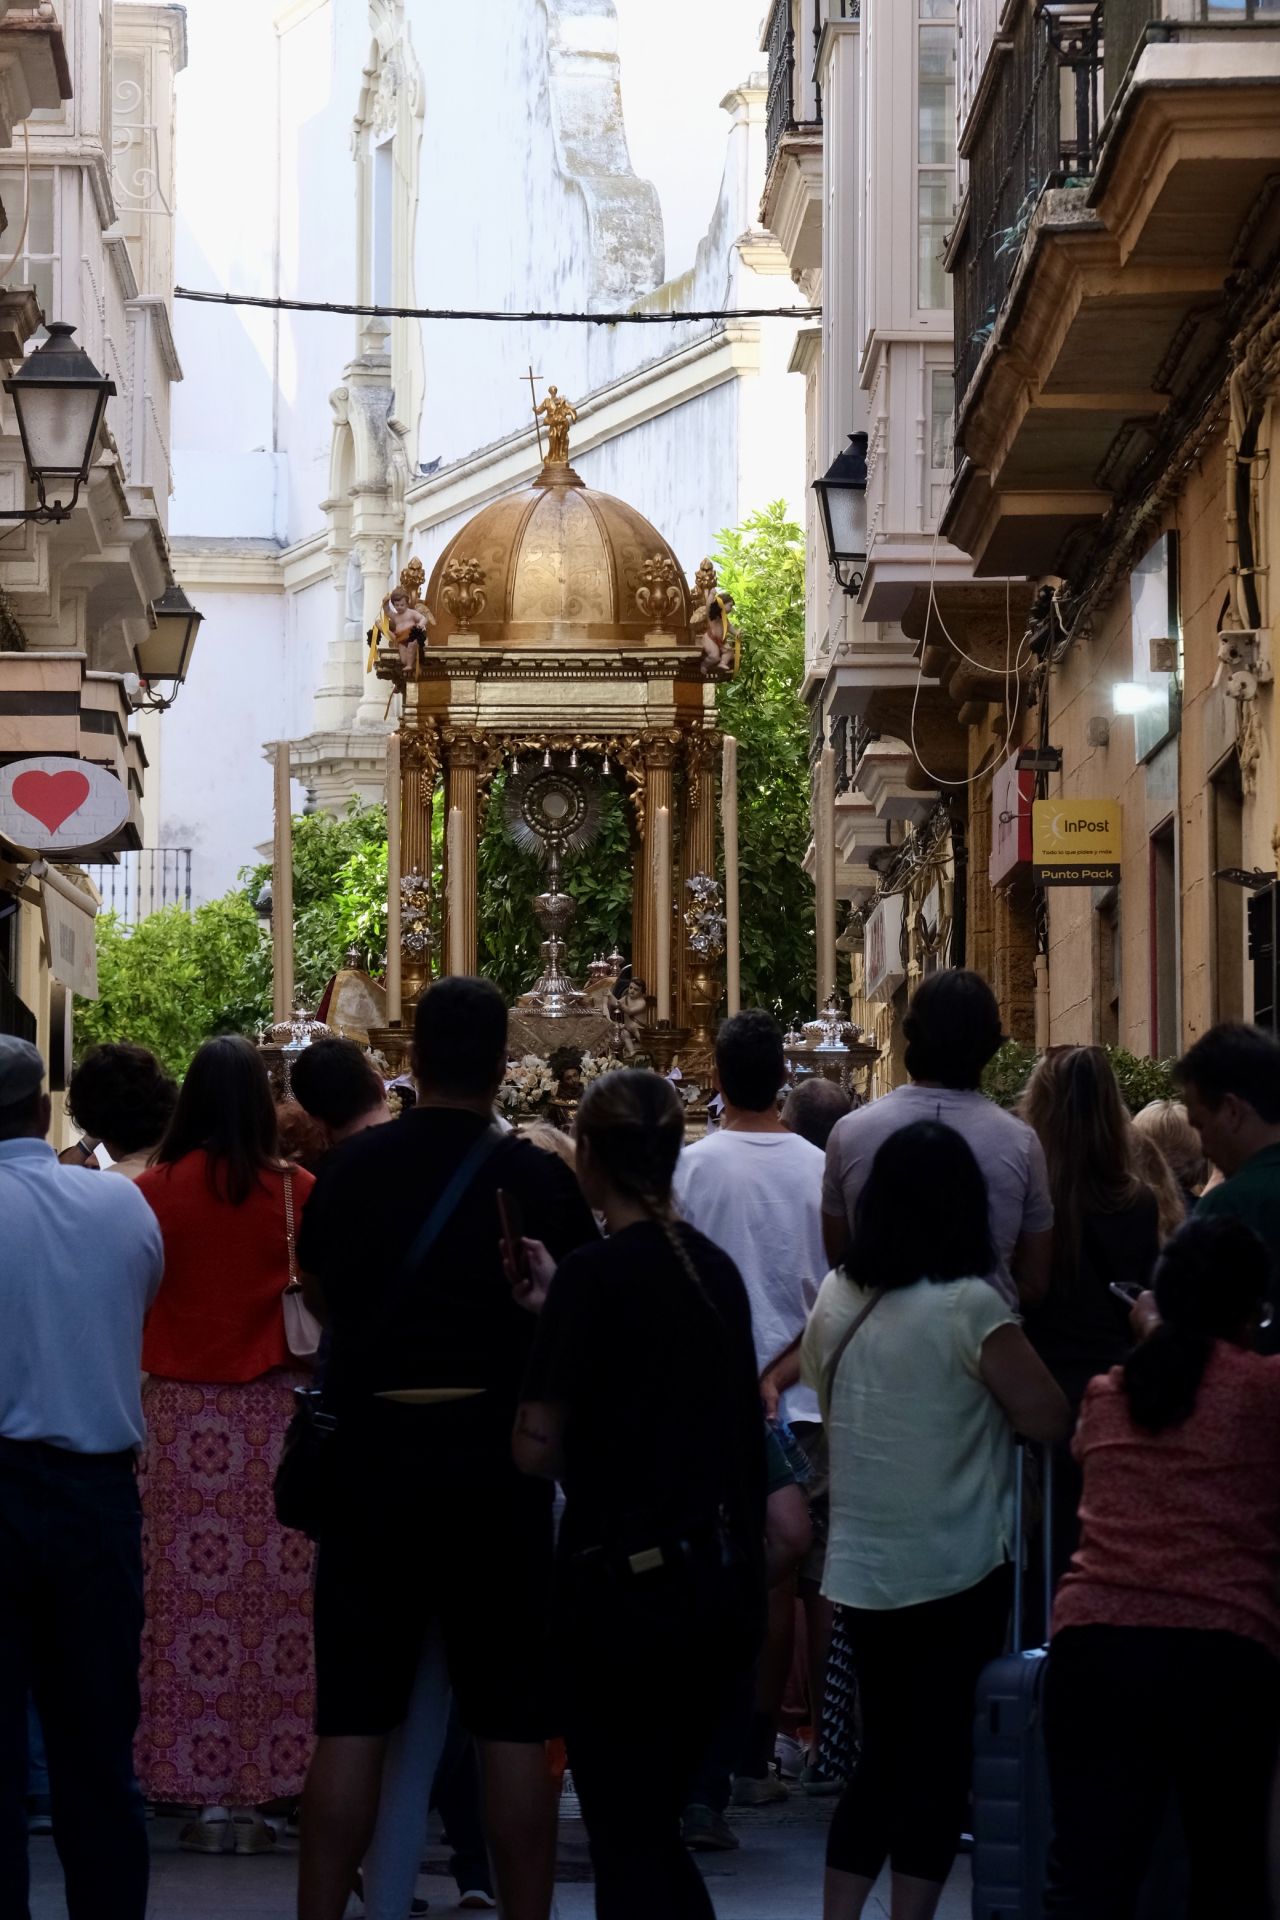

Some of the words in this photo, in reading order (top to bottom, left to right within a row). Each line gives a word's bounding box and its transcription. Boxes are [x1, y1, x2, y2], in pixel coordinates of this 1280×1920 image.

[1064, 820, 1109, 832] InPost
[1042, 870, 1079, 879] Punto
[1082, 870, 1113, 878] Pack
